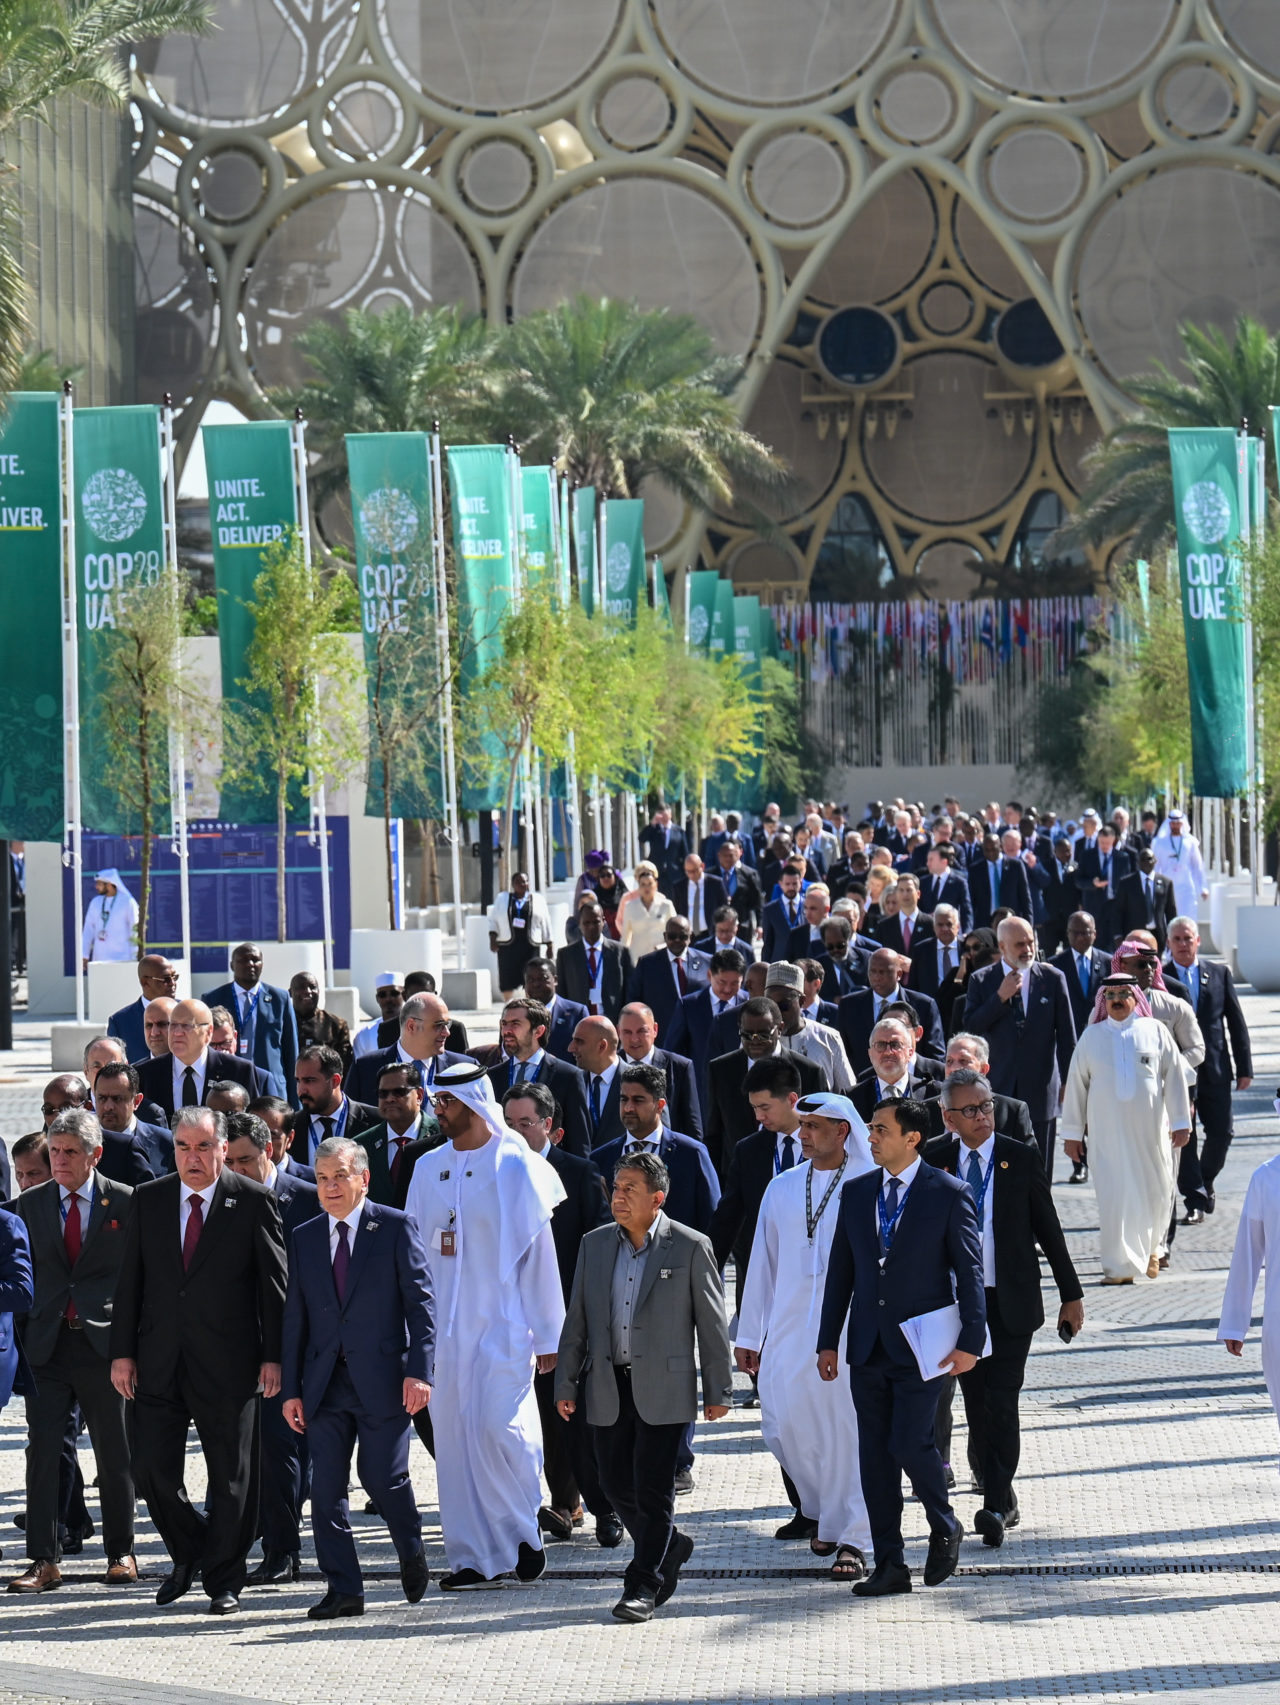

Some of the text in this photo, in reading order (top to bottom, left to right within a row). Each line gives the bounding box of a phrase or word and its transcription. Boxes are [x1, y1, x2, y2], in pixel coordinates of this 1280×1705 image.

[215, 479, 265, 498] UNITE.
[216, 503, 250, 522] ACT.
[218, 525, 287, 545] DELIVER.
[84, 551, 160, 591] COP28
[363, 599, 410, 633] UAE
[1188, 587, 1227, 619] UAE
